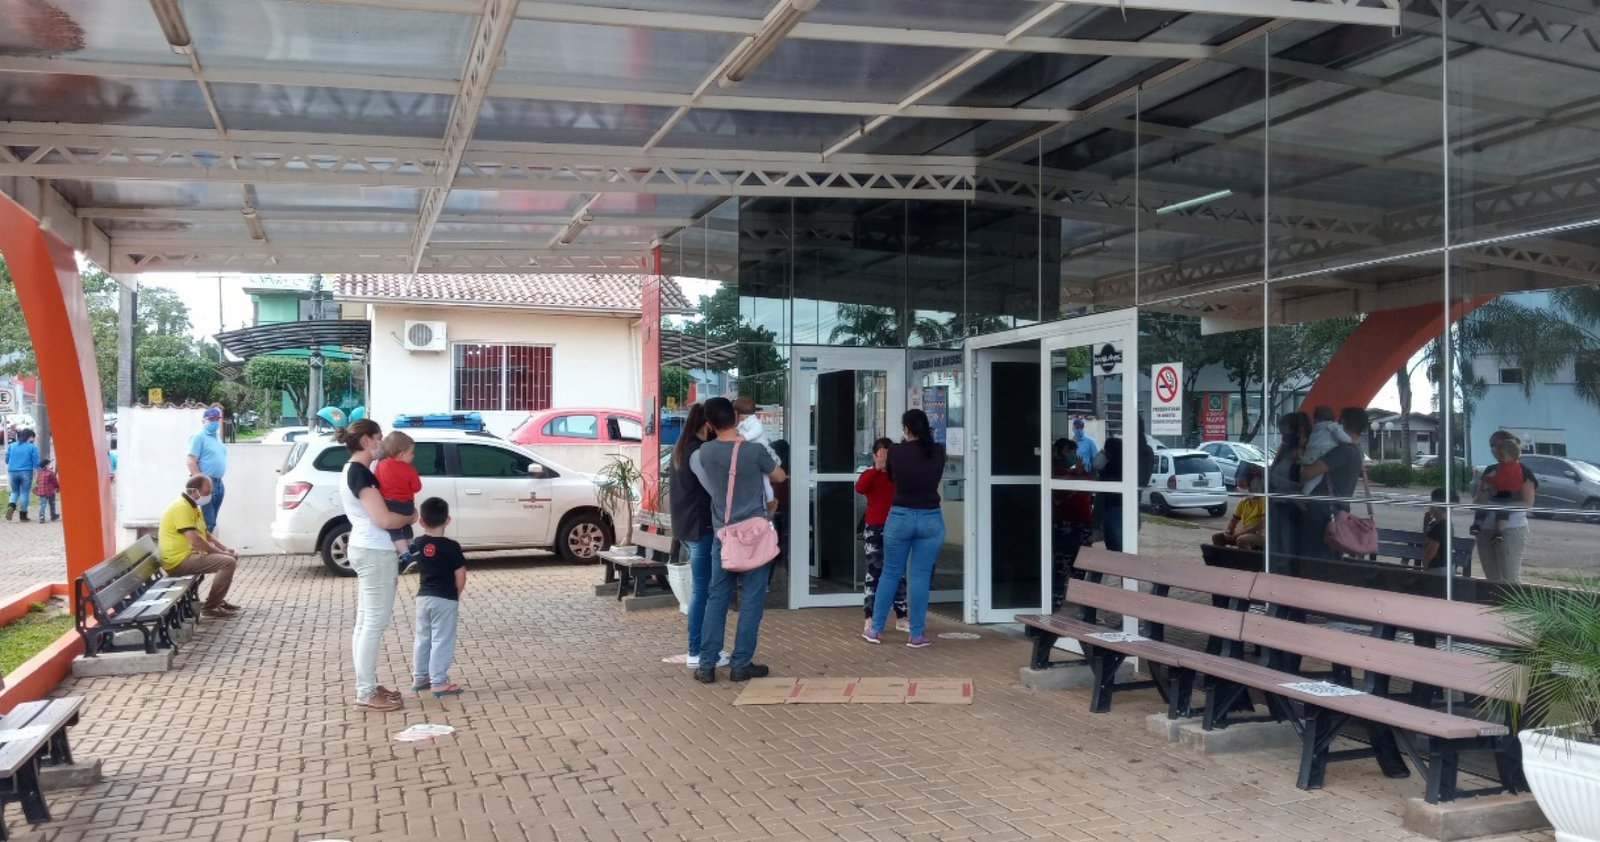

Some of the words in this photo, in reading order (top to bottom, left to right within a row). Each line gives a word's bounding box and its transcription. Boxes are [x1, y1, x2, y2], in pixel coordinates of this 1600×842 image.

[912, 358, 933, 370] QUADRO
[934, 357, 942, 367] DE
[942, 353, 962, 366] AVISOS
[1, 393, 7, 401] E
